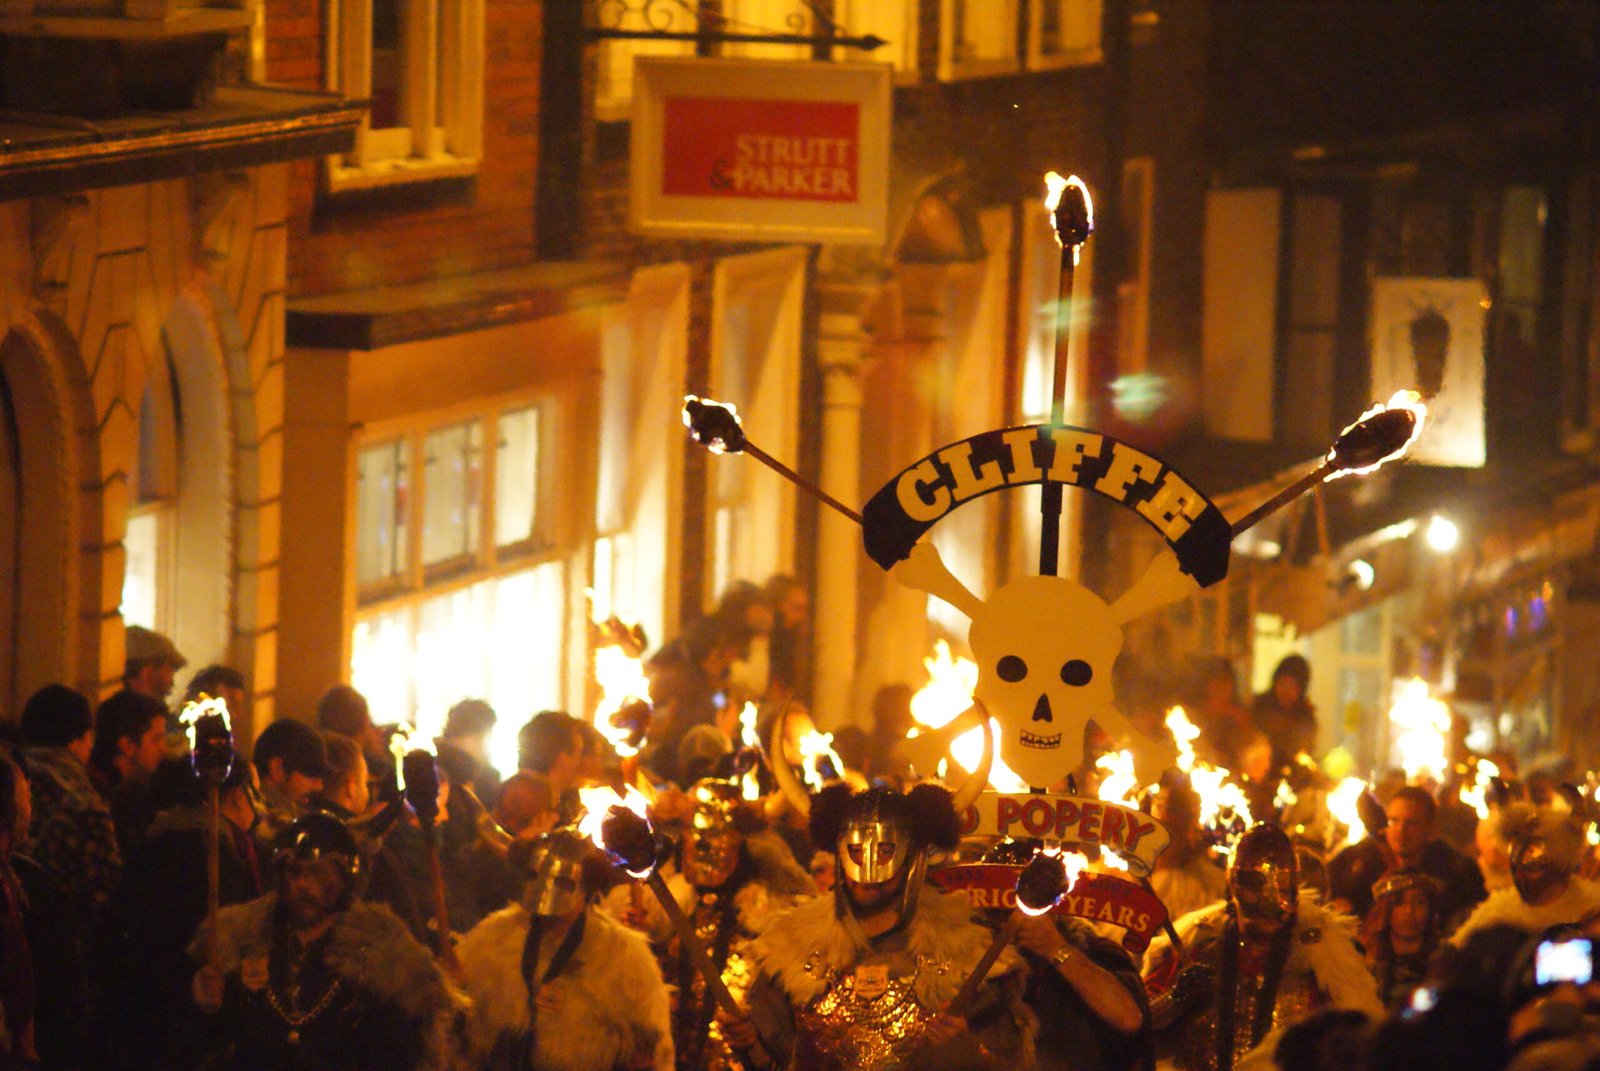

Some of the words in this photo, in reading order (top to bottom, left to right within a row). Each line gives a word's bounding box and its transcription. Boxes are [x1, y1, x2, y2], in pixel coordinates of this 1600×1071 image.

[737, 135, 851, 163] STRUTT
[732, 165, 852, 194] PARKER
[896, 427, 1207, 542] CLIFFE
[997, 797, 1155, 852] POPERY
[1066, 894, 1151, 932] YEARS
